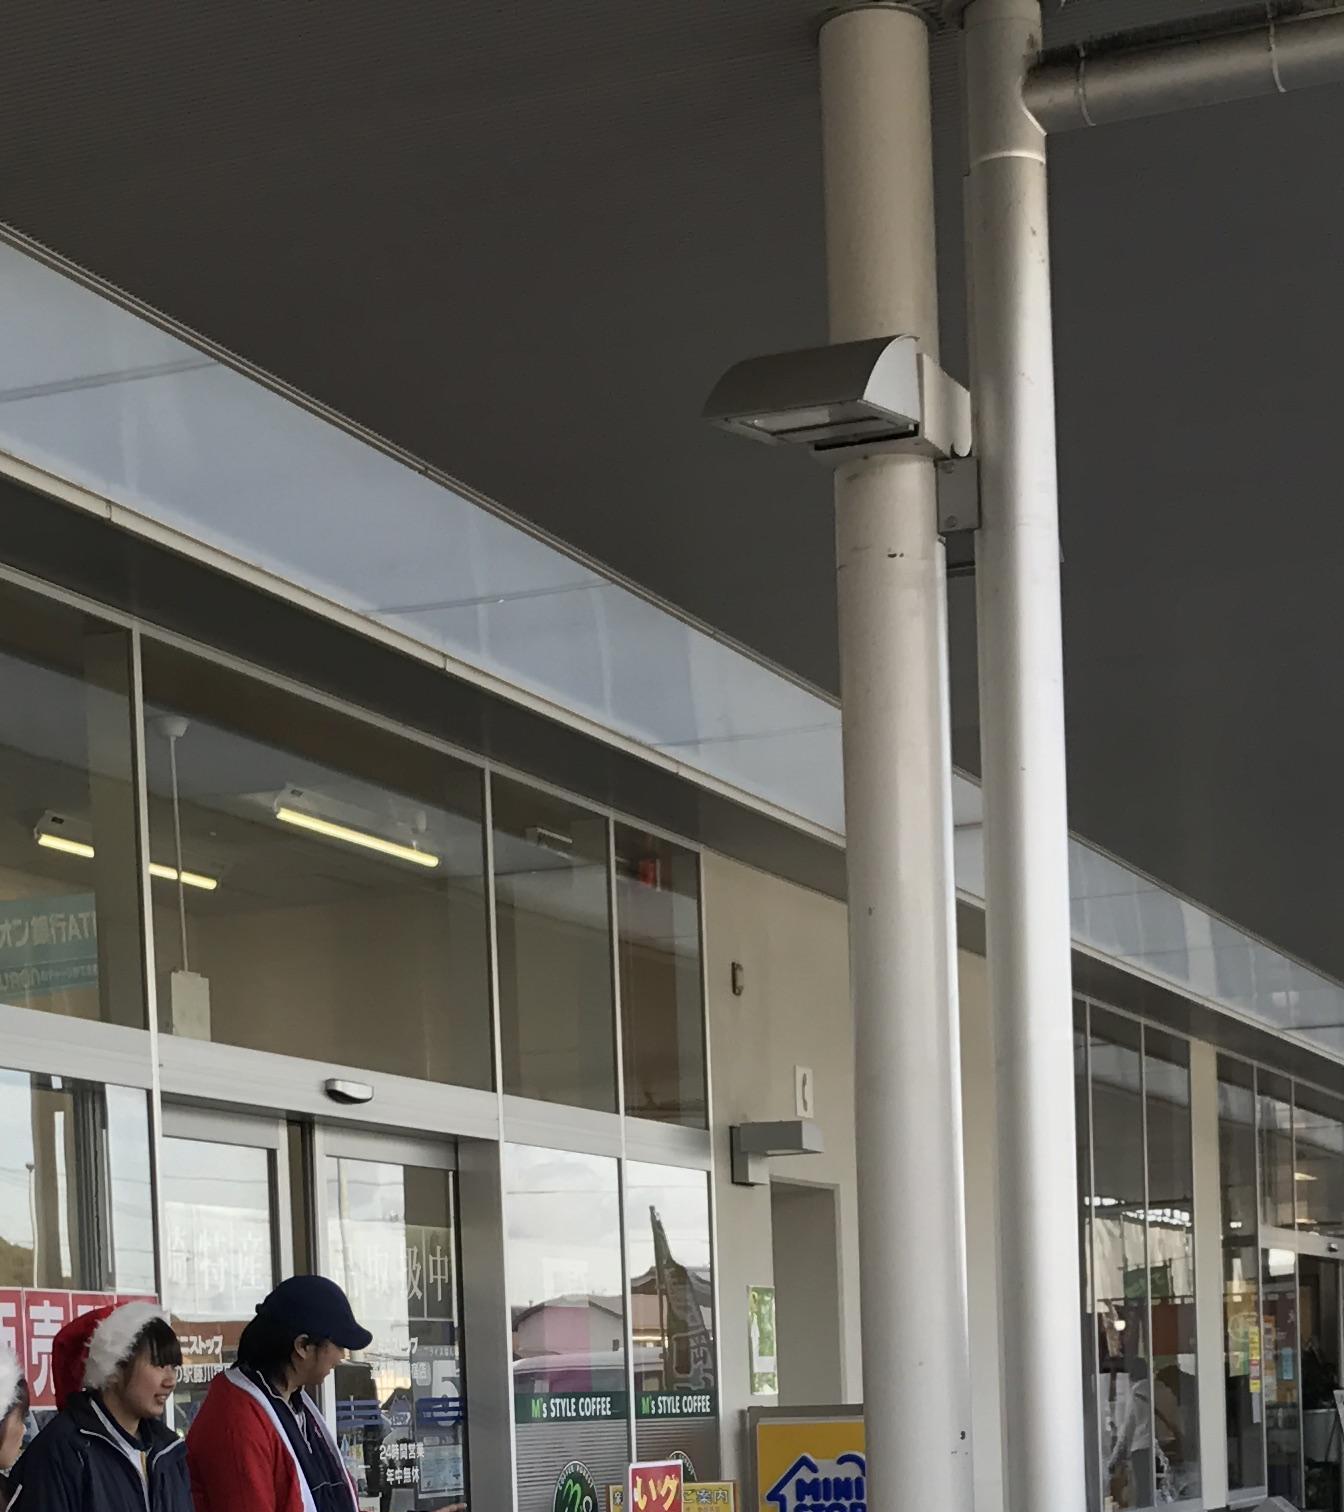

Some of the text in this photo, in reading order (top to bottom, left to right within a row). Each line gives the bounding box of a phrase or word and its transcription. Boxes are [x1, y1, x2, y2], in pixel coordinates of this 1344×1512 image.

[175, 1334, 224, 1357] ニストップ
[531, 1396, 612, 1417] M's STYLE COFFEE
[657, 1395, 680, 1414] STYLE
[682, 1394, 711, 1413] COFFEE
[379, 1442, 424, 1460] 24時間営業
[795, 1477, 865, 1502] MINI
